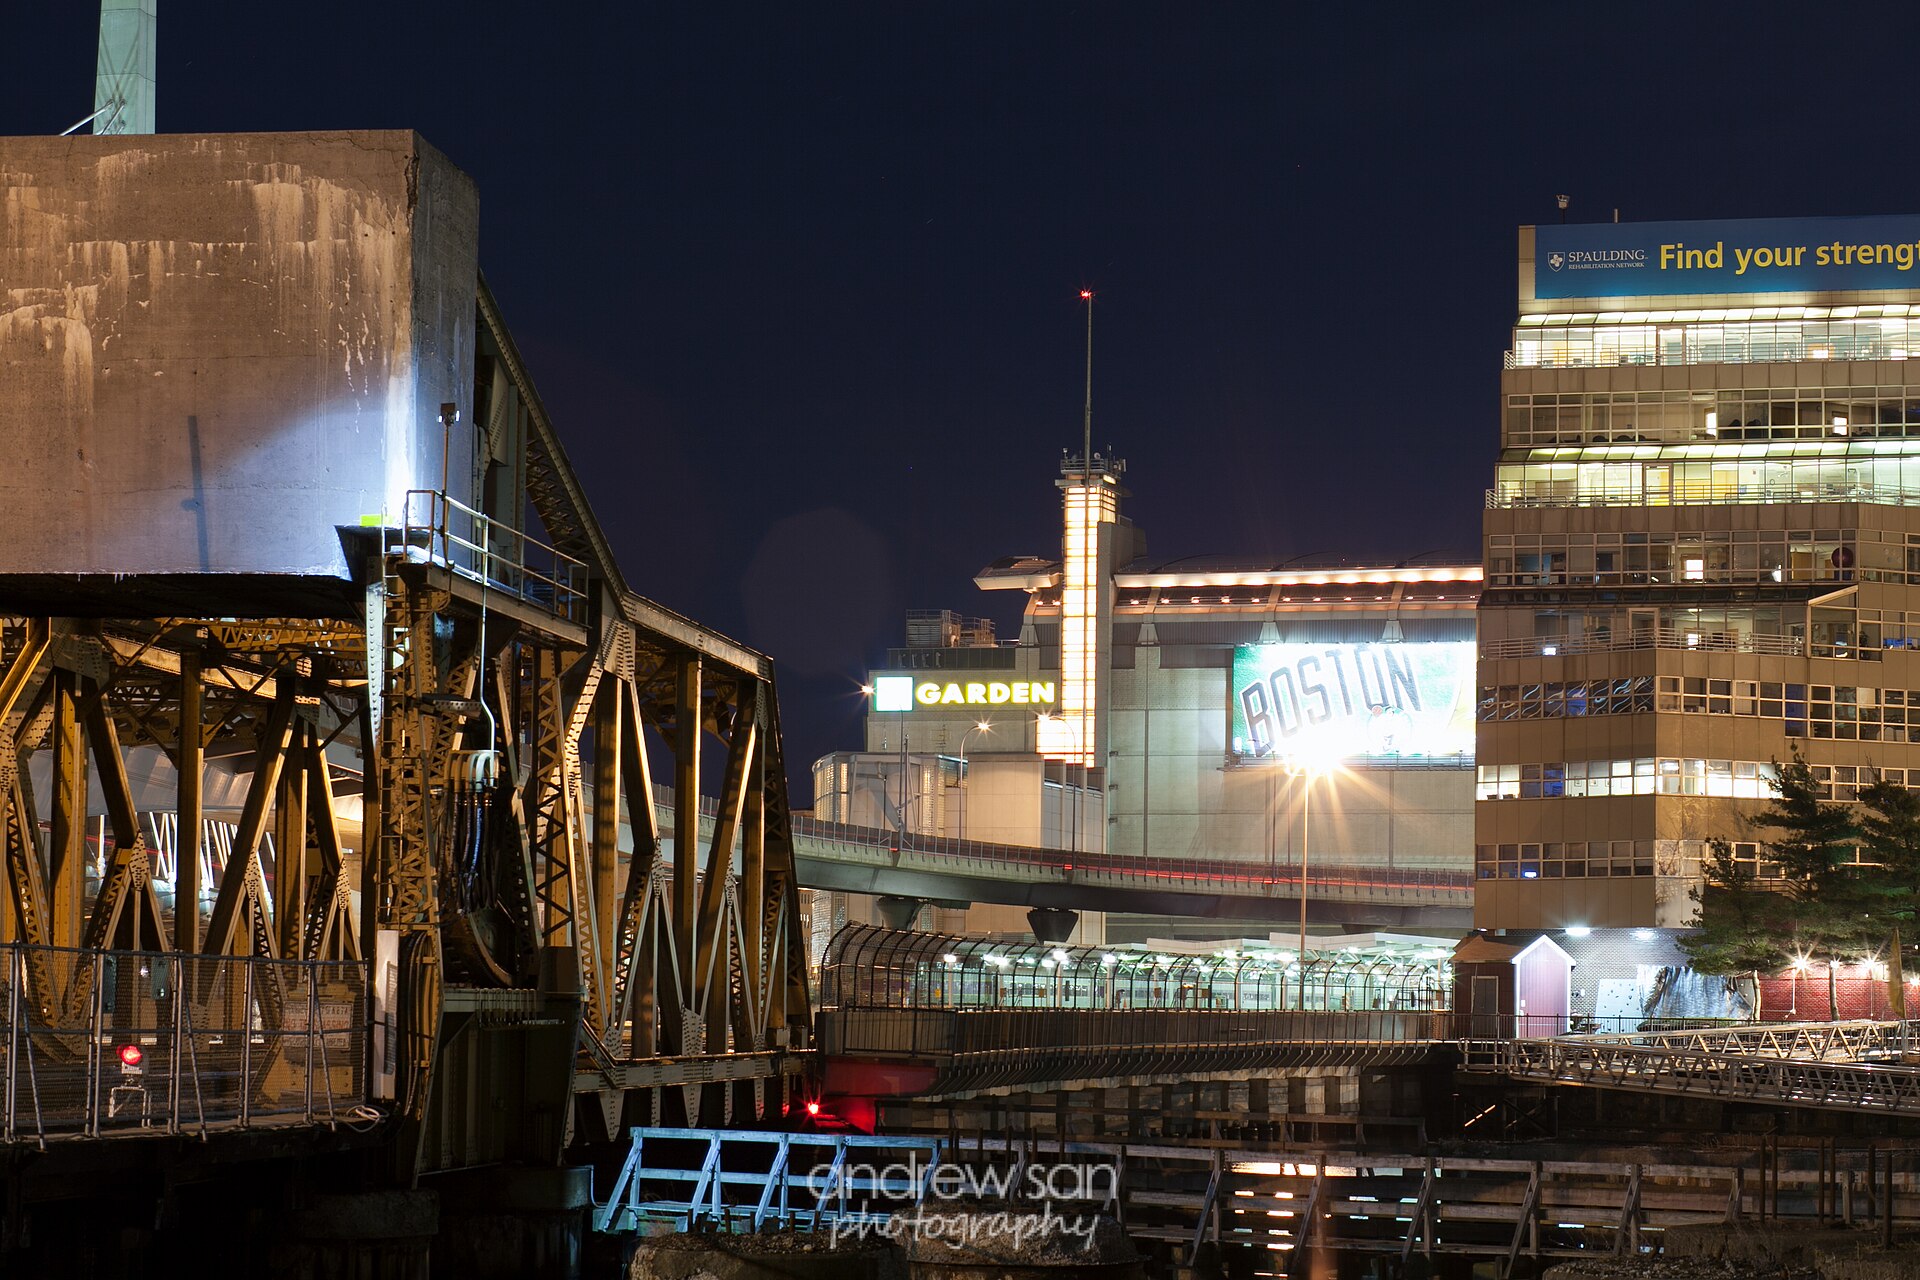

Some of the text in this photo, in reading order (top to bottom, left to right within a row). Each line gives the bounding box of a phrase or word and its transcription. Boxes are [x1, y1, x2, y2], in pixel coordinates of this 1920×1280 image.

[1568, 249, 1645, 263] SPAULDING
[1660, 241, 1723, 270] Find
[1734, 246, 1807, 275] your
[915, 681, 1055, 705] GARDEN
[1239, 645, 1422, 758] BOSTON
